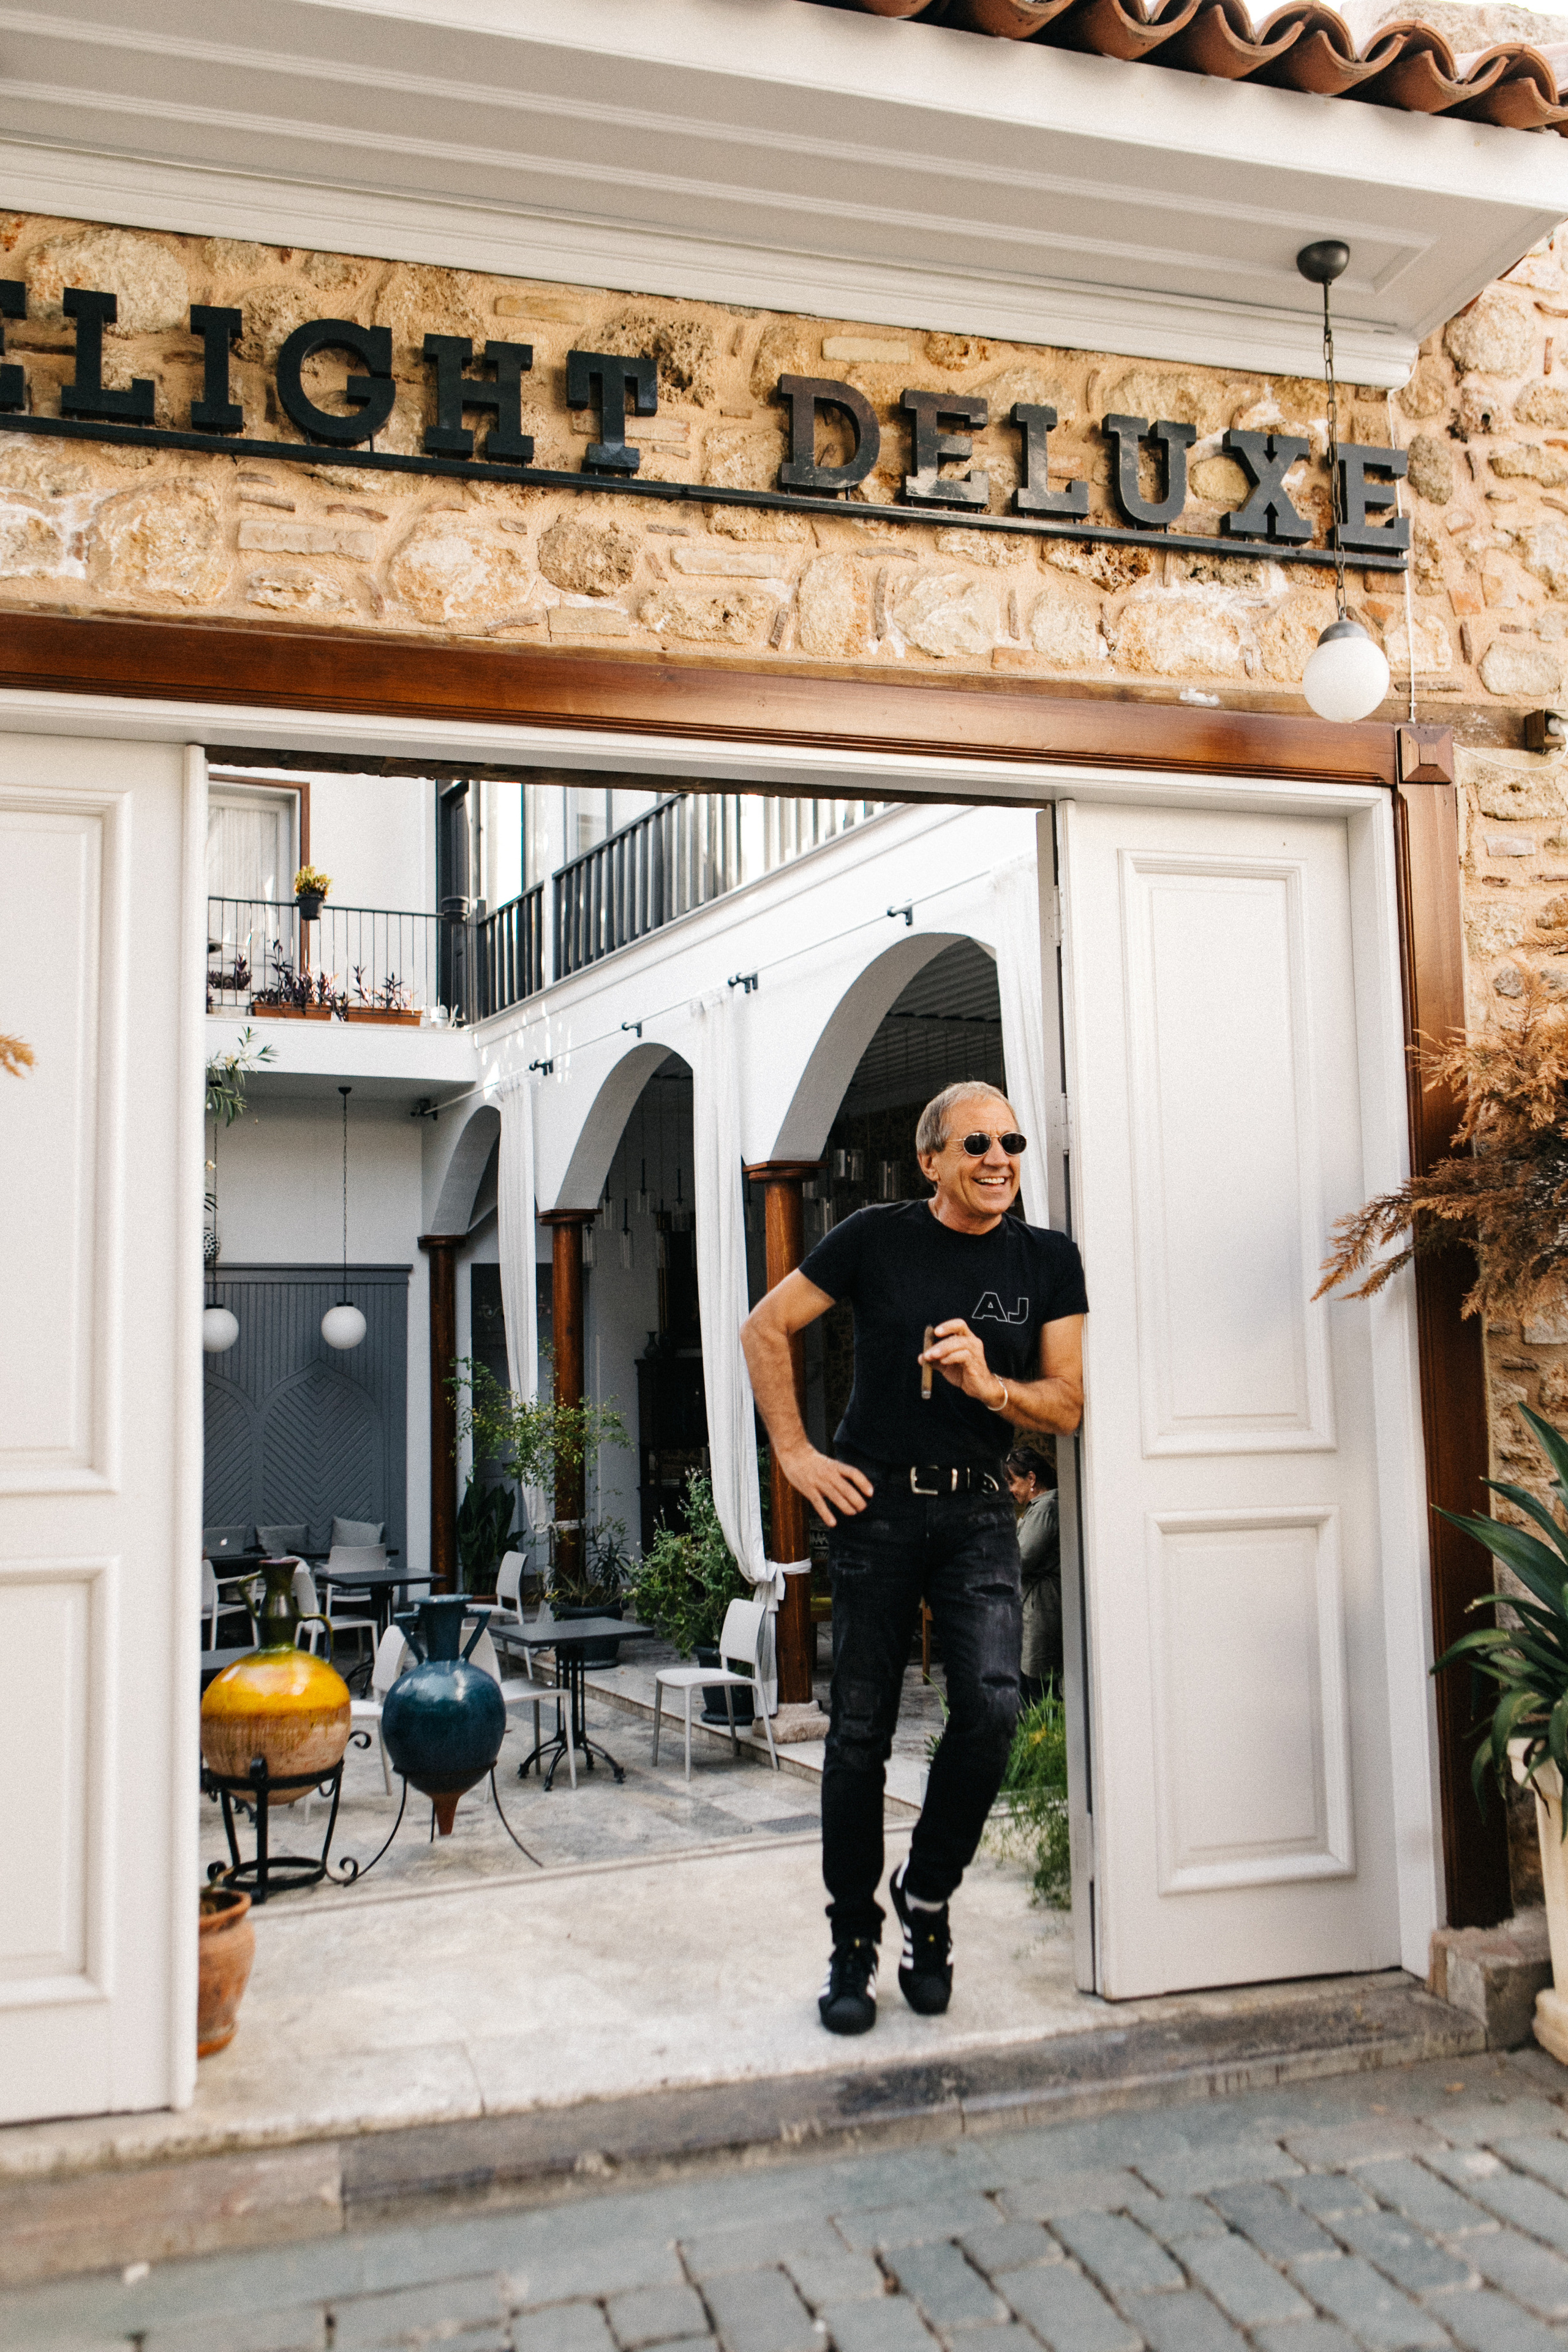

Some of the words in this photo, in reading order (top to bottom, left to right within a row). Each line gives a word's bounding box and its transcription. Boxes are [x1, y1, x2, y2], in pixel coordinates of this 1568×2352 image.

[0, 279, 657, 473] LIGHT
[777, 373, 1410, 551] DELUXE
[971, 1292, 1029, 1324] AJ
